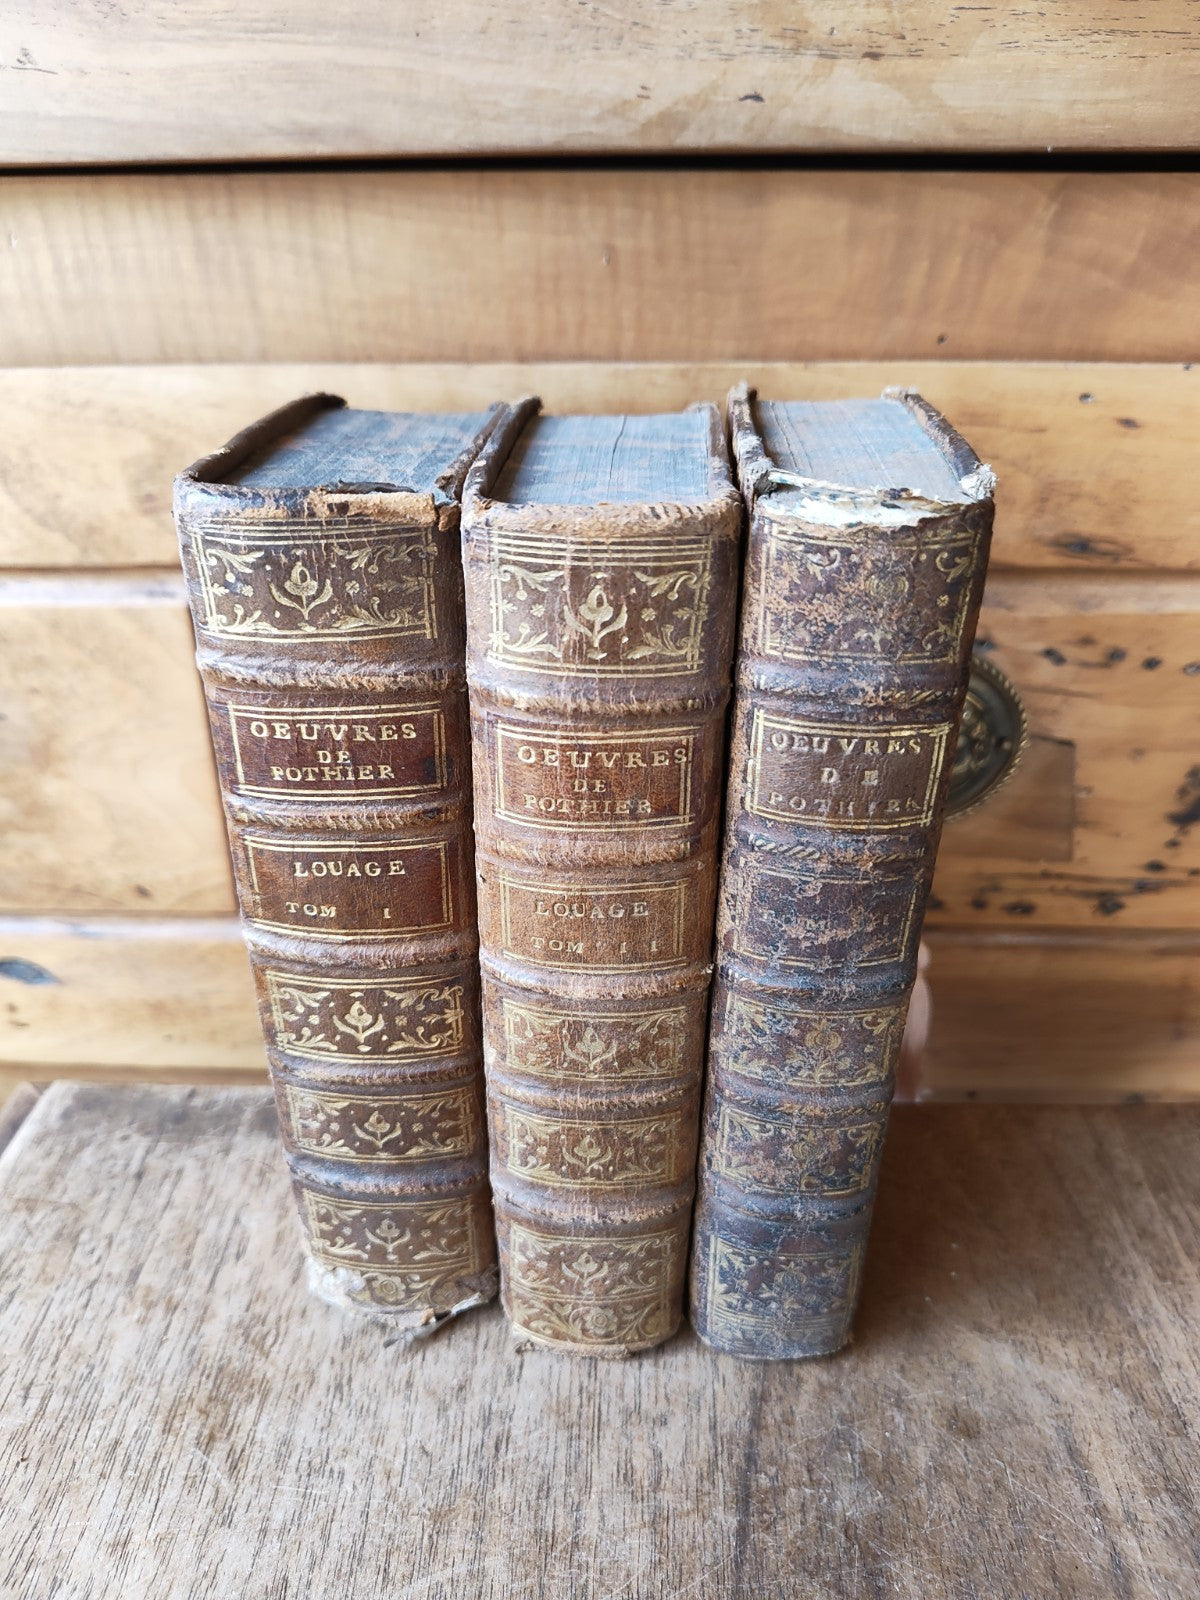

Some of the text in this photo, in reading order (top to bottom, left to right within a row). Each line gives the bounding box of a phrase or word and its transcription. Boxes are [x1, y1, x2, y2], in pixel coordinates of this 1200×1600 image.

[250, 720, 417, 742] OEUVRES
[770, 731, 922, 756] OEUVRES
[317, 750, 351, 764] DE
[517, 745, 688, 767] OEUVRES
[270, 764, 395, 782] POTHIER
[573, 778, 607, 793] DE
[523, 793, 653, 815] POTHIER
[293, 860, 406, 878] LOUAGE
[285, 901, 337, 918] TOM
[534, 901, 649, 919] LOUAGE
[531, 936, 584, 954] TOM
